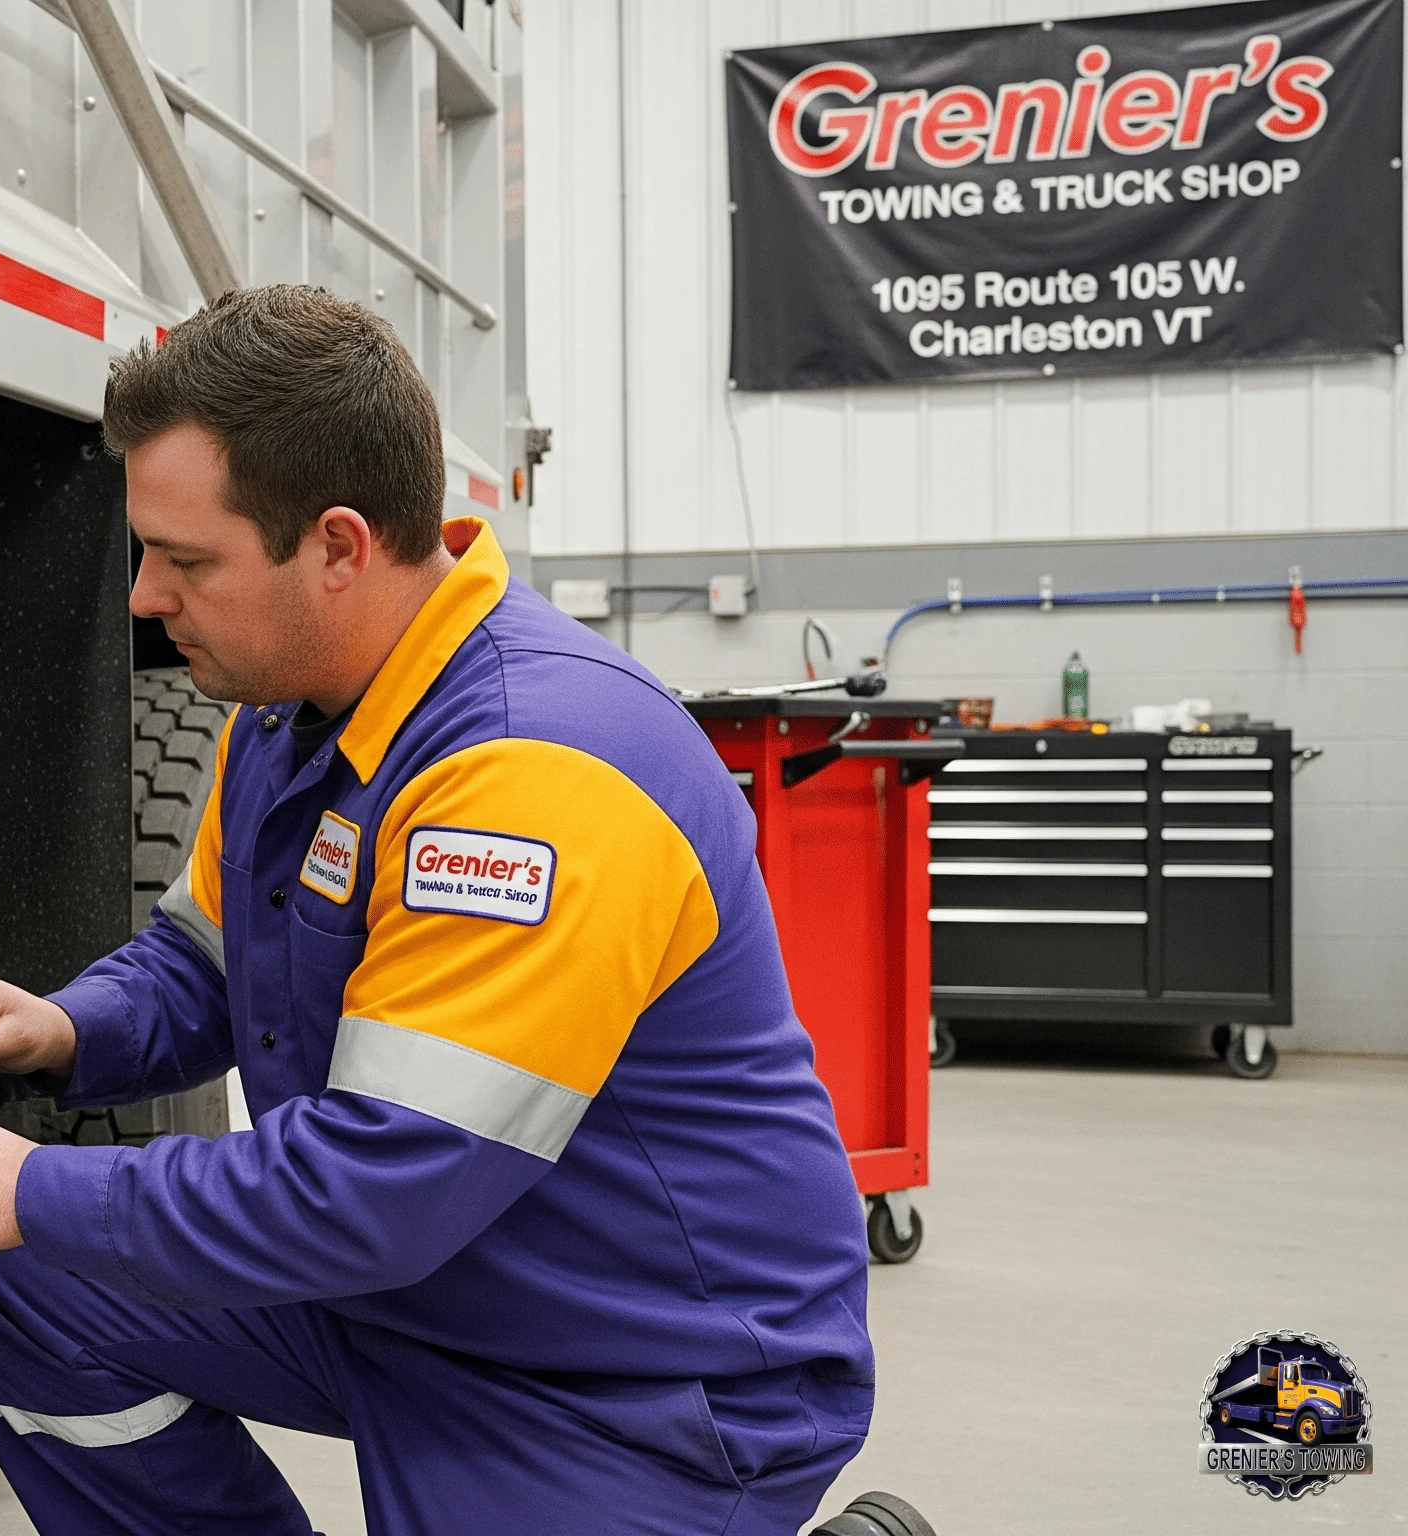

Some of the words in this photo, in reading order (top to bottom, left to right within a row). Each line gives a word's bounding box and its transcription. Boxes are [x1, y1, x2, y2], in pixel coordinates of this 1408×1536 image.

[769, 35, 1333, 177] Grenier's
[819, 181, 984, 225] TOWING
[992, 179, 1024, 214] &
[1031, 168, 1174, 212] TRUCK
[1181, 158, 1301, 201] SHOP
[871, 273, 965, 313] 1095
[975, 269, 1098, 309] Route
[1109, 260, 1183, 300] 105
[1189, 256, 1245, 295] W.
[909, 314, 1143, 358] Charleston
[1152, 305, 1213, 345] VT
[416, 844, 543, 886] Grenier's
